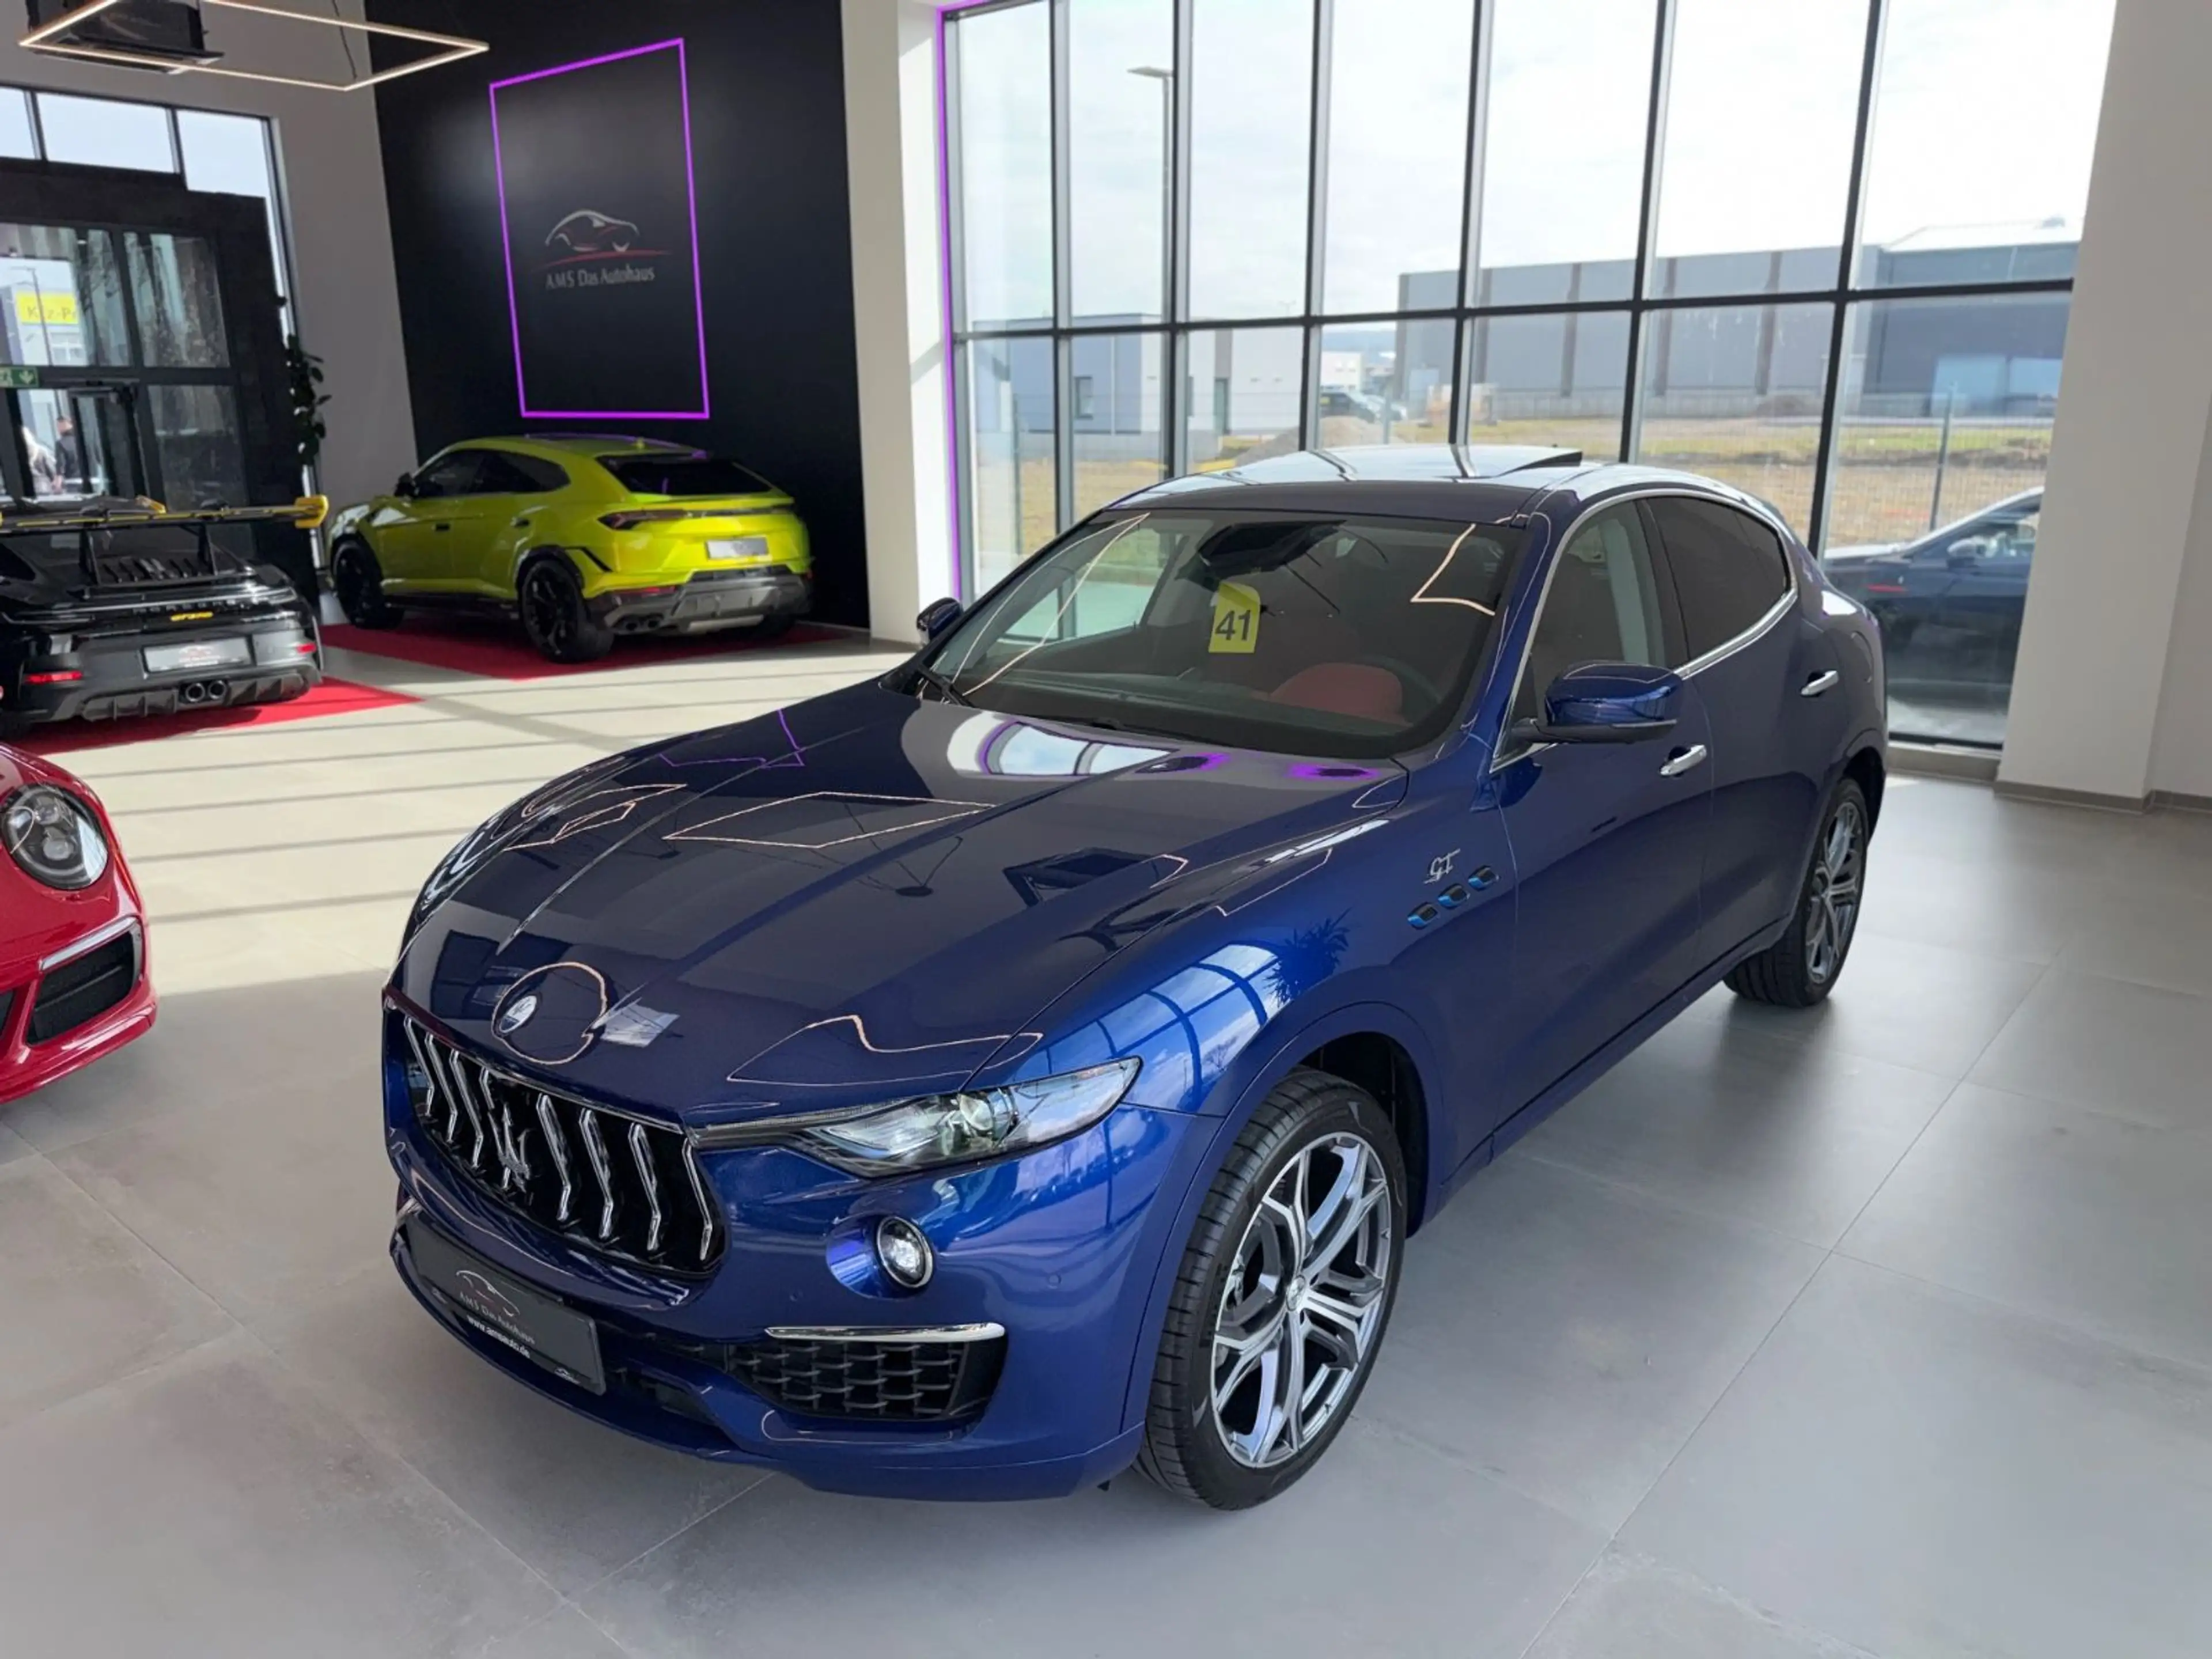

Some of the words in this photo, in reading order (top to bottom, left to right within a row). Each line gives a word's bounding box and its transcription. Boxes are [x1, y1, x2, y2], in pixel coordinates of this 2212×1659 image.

[546, 271, 575, 289] AMS
[577, 268, 599, 286] Das
[600, 263, 656, 285] Autohaus
[1215, 609, 1251, 641] 41
[1423, 848, 1460, 884] GT
[459, 1291, 479, 1310] AMS
